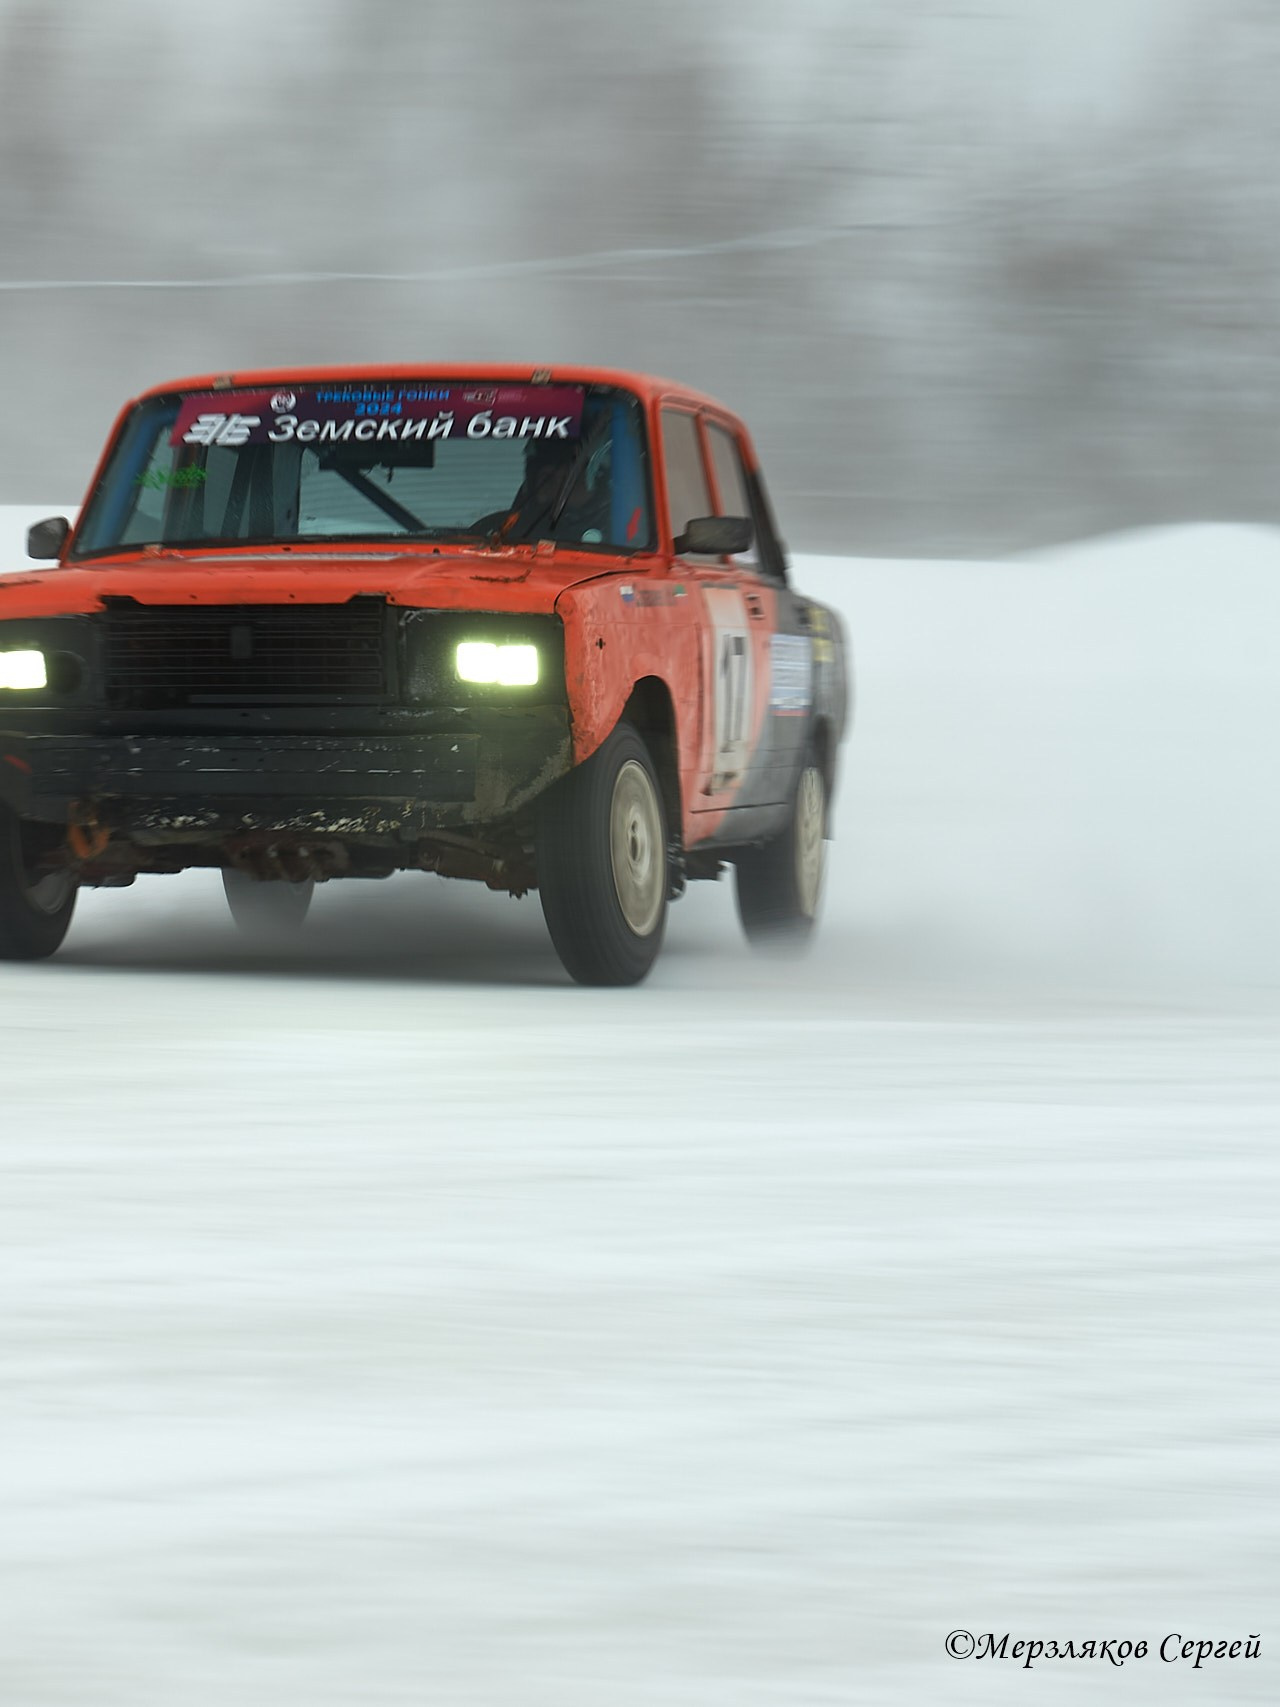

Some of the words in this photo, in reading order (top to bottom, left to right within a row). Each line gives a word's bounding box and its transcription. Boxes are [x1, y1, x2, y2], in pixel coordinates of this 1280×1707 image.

[316, 388, 394, 404] ТРЕКОВЫЕ
[398, 388, 450, 402] ГОНКИ
[354, 402, 403, 416] 2024
[268, 410, 454, 442] Земский
[466, 409, 571, 440] банк
